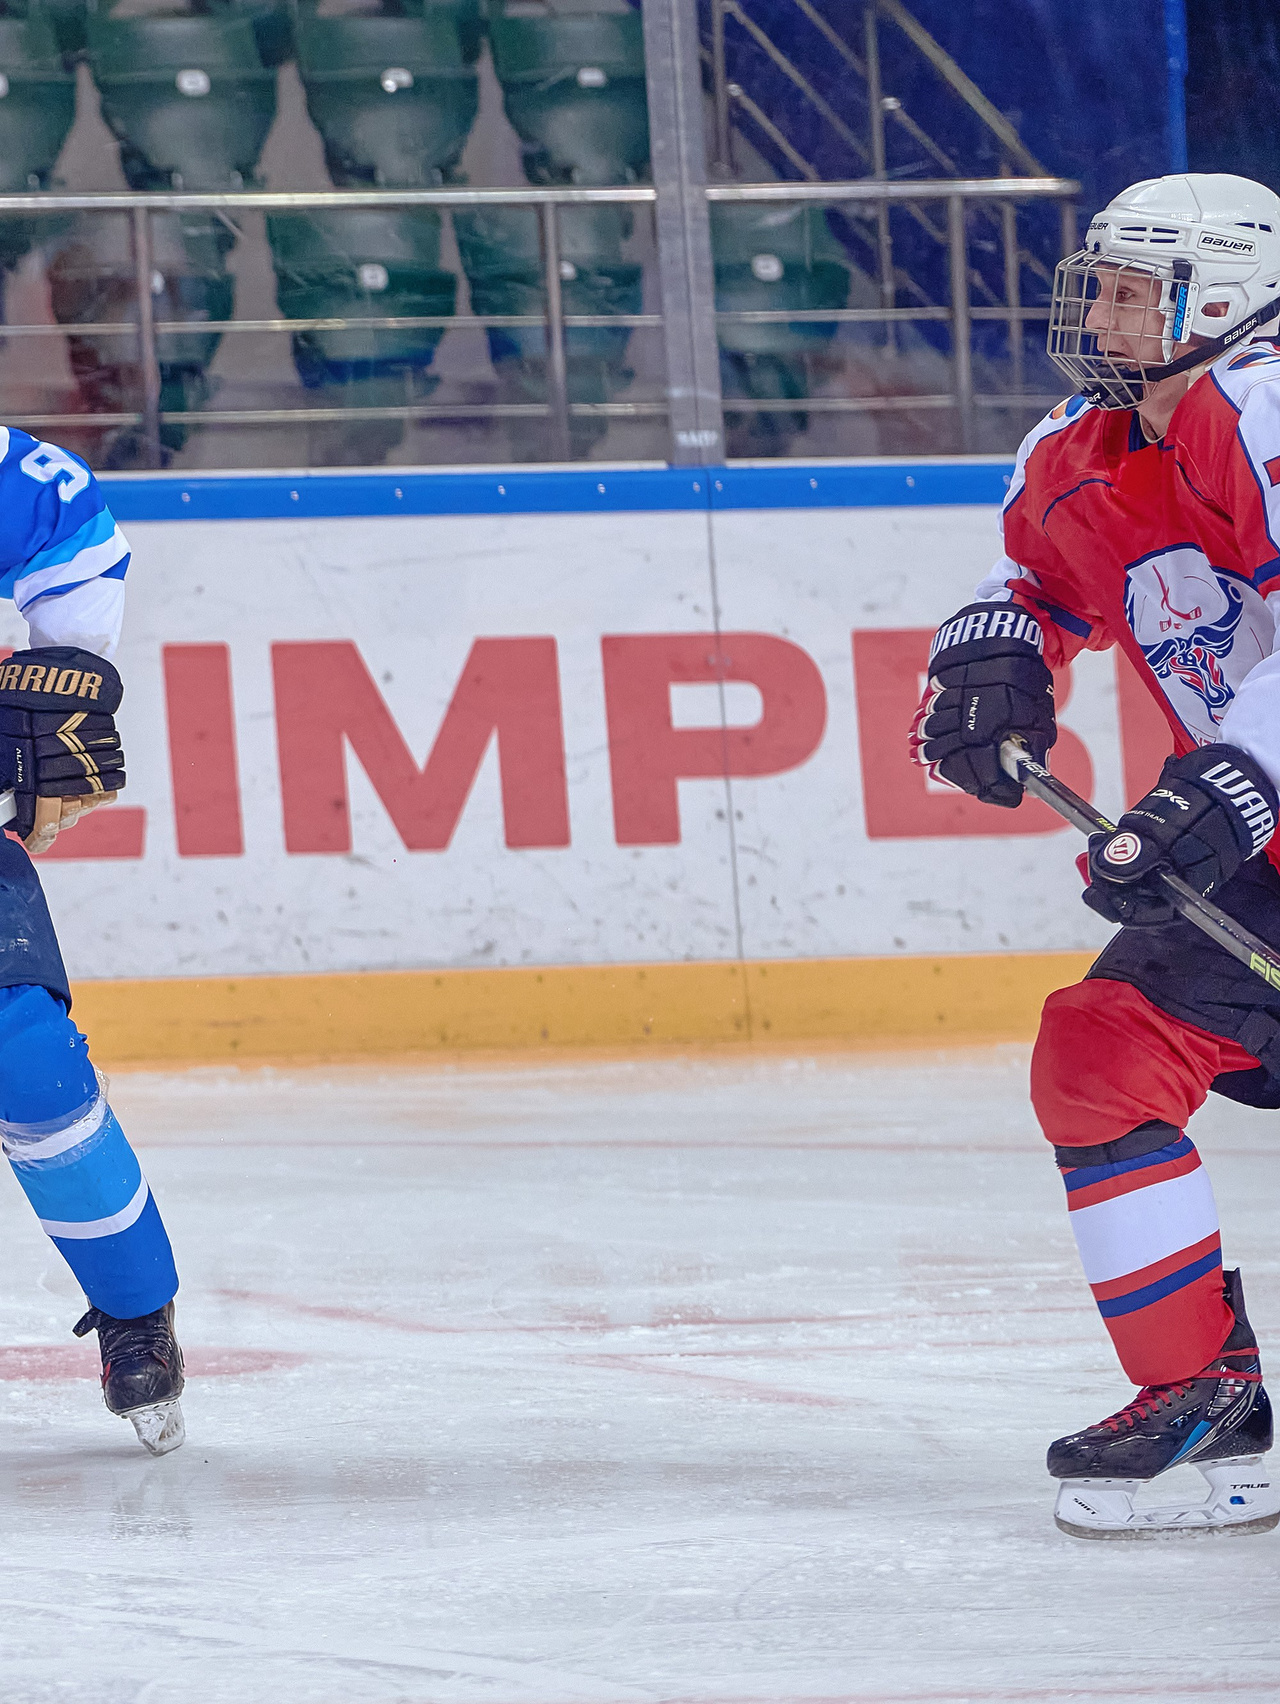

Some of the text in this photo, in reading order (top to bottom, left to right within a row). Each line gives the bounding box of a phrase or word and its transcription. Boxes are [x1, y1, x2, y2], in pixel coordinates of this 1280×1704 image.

[1201, 235, 1254, 253] BAUER
[1173, 286, 1188, 340] BAUER
[1223, 317, 1258, 346] BAUER
[19, 435, 91, 505] 9
[928, 610, 1045, 663] WARRIO
[1230, 1482, 1271, 1490] TRUE
